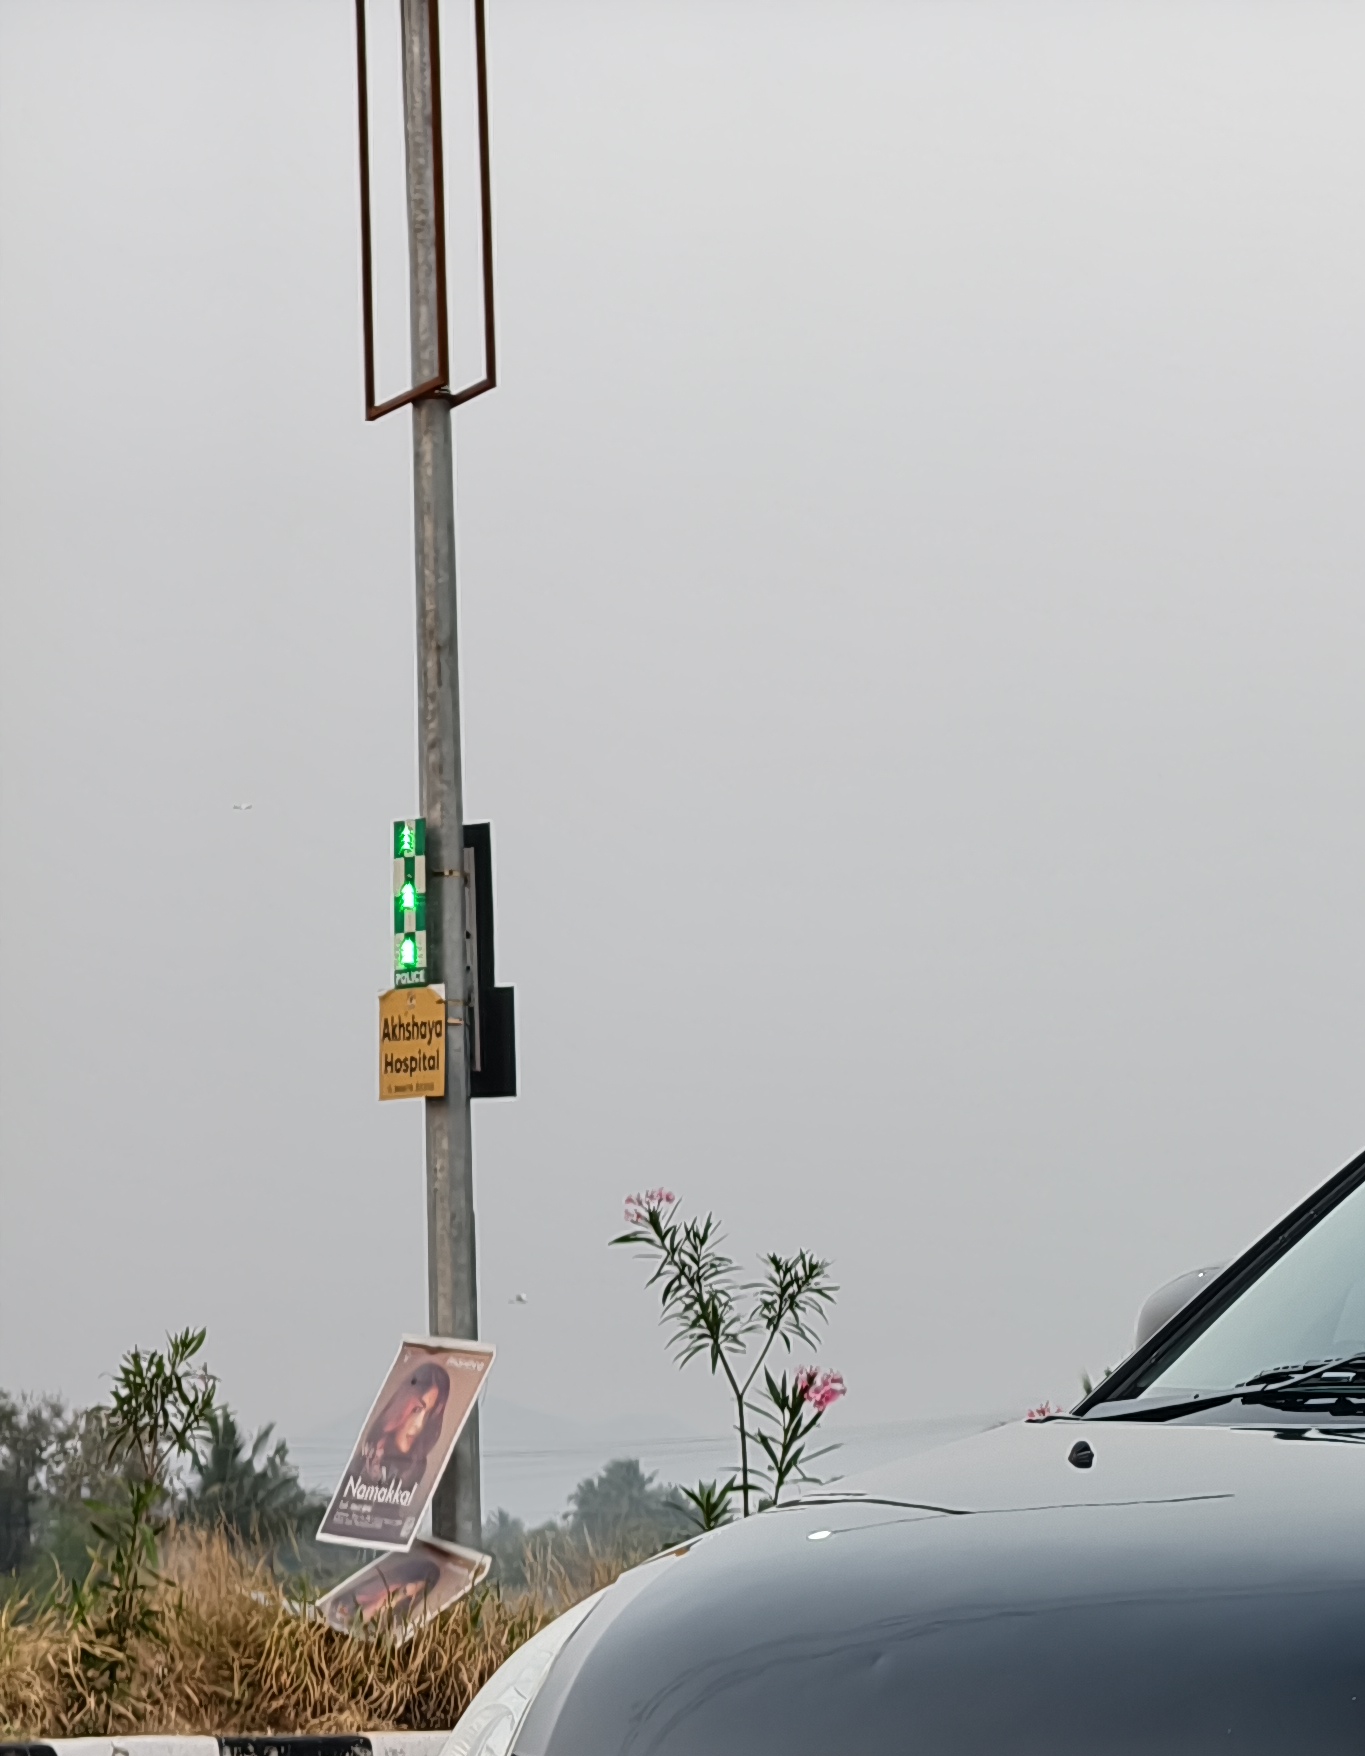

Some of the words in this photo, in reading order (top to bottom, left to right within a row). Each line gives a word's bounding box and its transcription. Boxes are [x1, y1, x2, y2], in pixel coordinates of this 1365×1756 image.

[395, 969, 426, 986] POLICE
[381, 1013, 443, 1046] Akhshaya
[383, 1048, 440, 1078] Hospital
[342, 1474, 419, 1507] Namakkal
